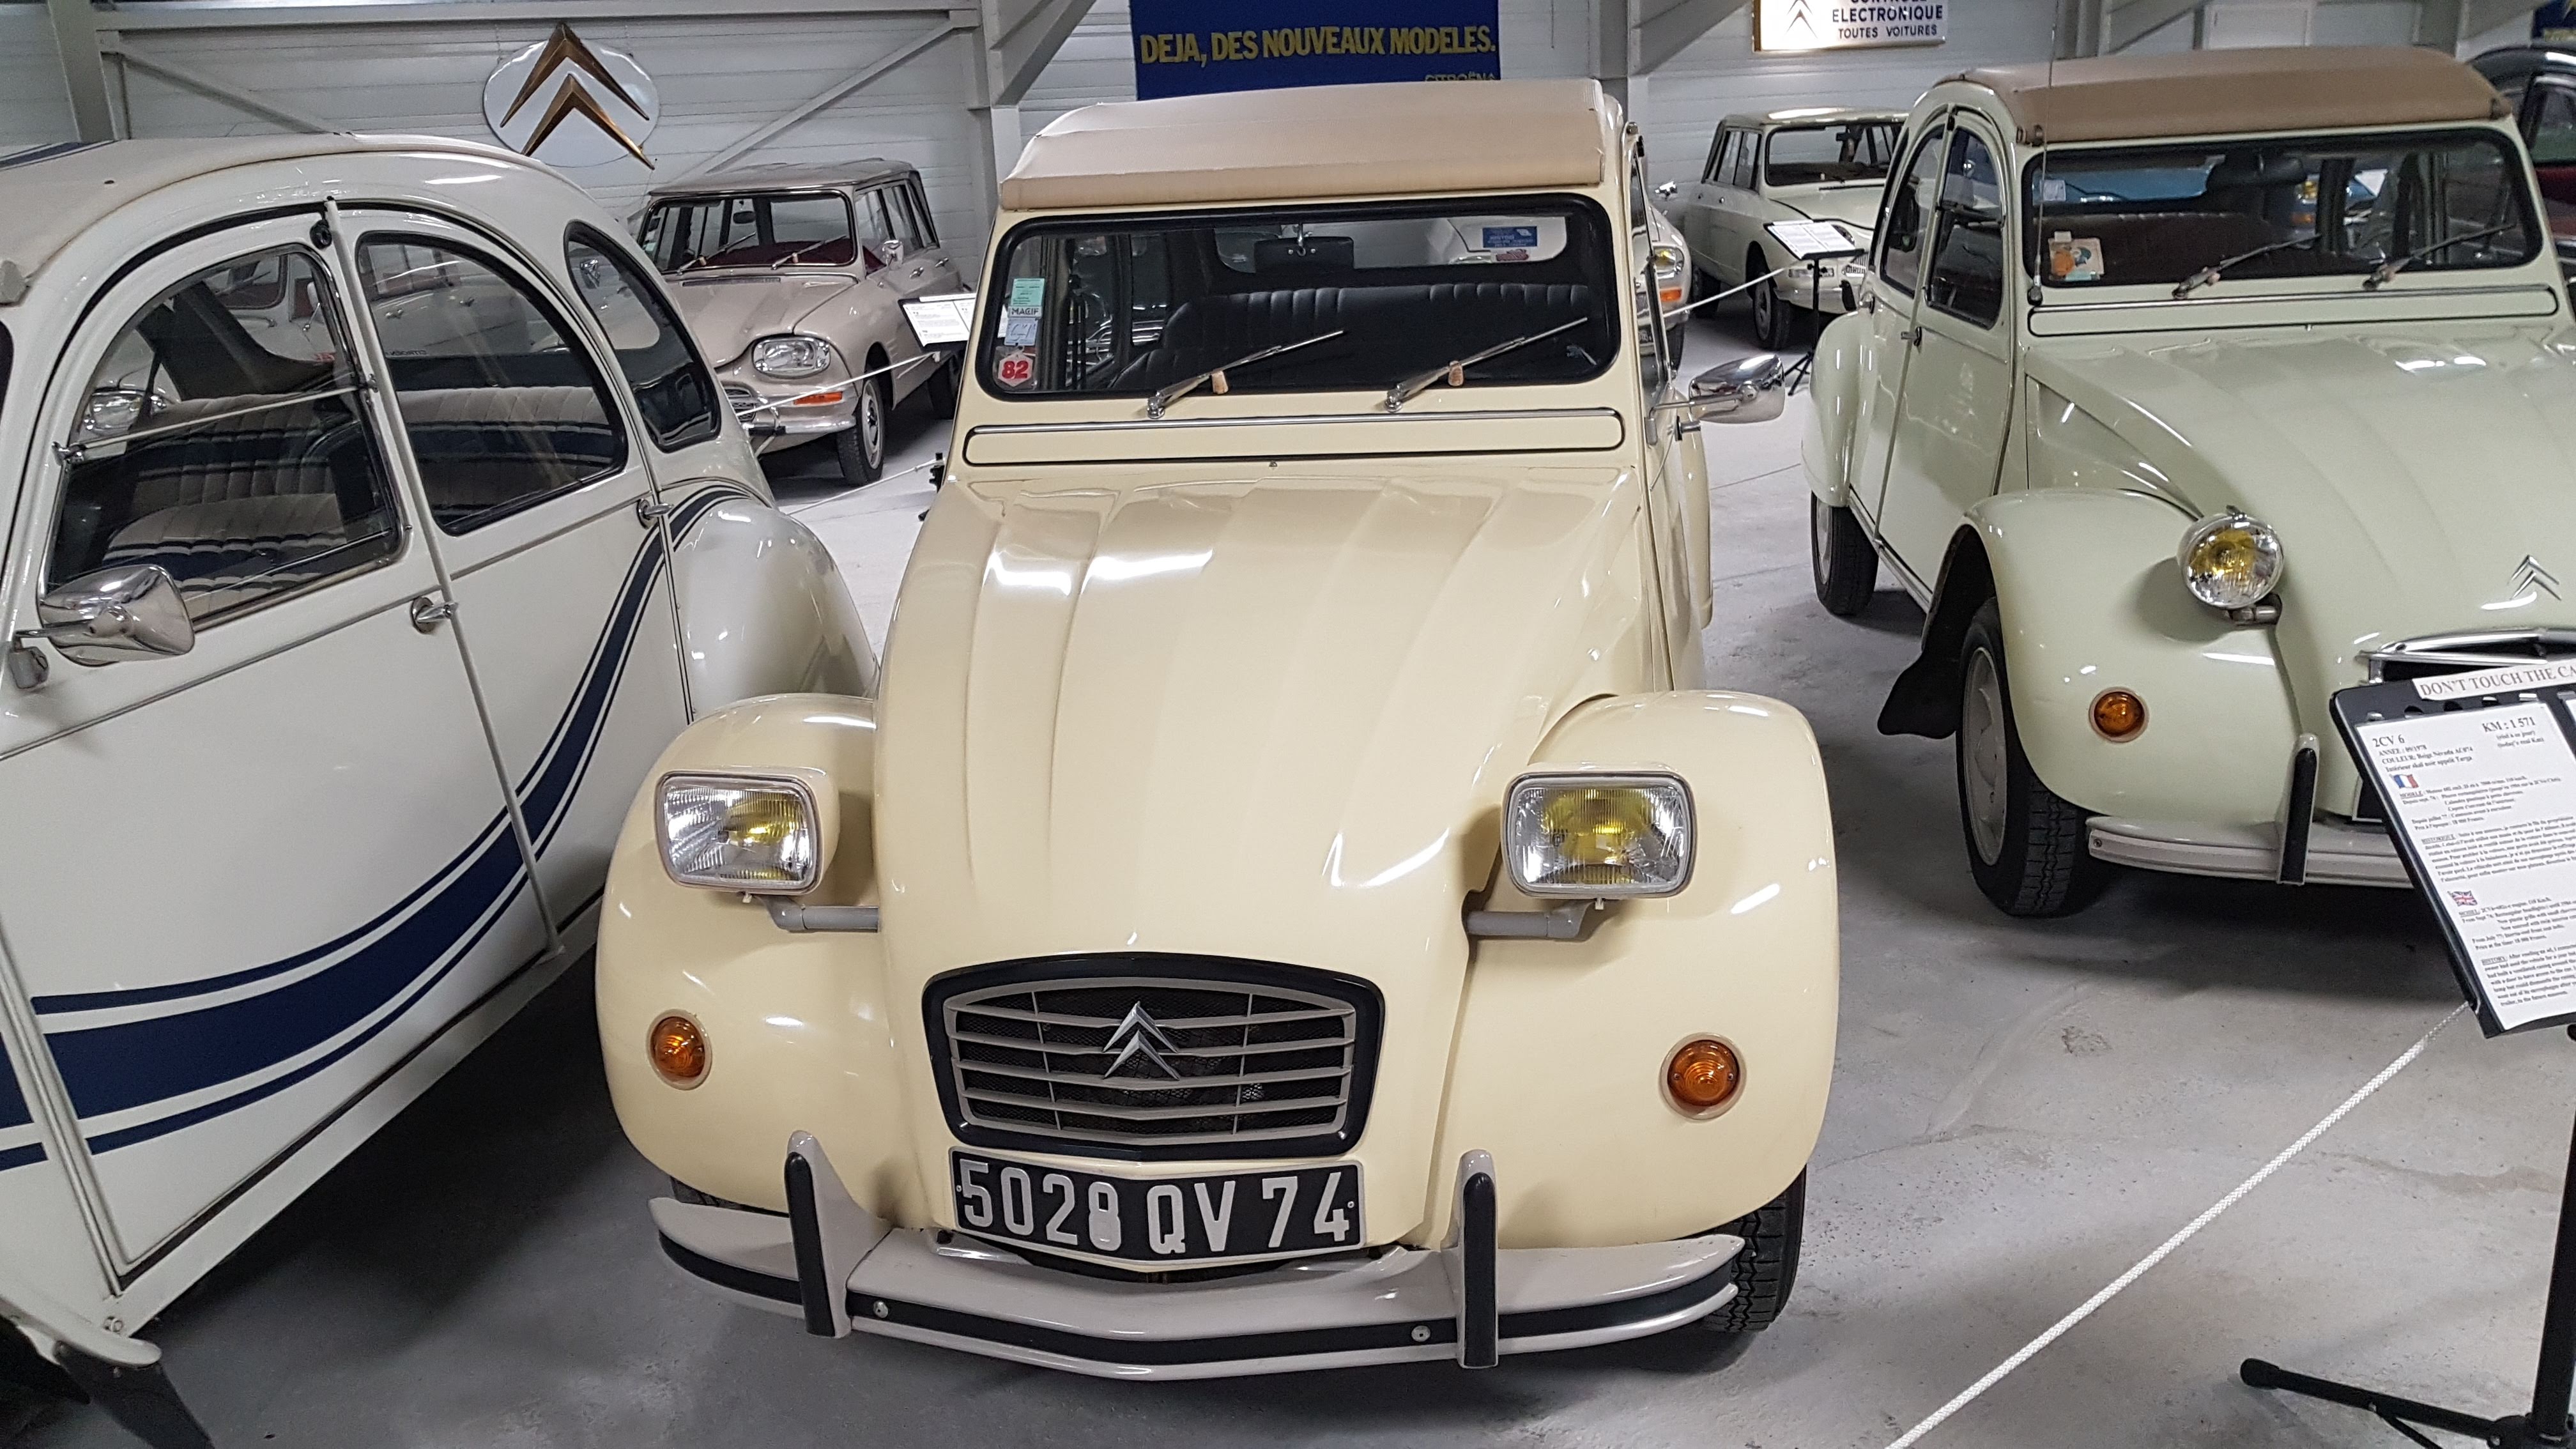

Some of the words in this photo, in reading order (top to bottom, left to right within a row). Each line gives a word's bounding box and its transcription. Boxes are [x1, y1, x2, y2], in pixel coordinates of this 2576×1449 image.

[1832, 4, 1943, 23] ELECTRONIQUE
[1838, 27, 1878, 39] TOUTES
[1886, 24, 1937, 37] VOITURES
[1140, 33, 1208, 68] DEJA,
[1211, 31, 1259, 61] DES
[1262, 26, 1386, 59] NOUVEAUX
[1390, 26, 1497, 56] MODELES.
[1001, 360, 1029, 379] 82
[2420, 679, 2466, 697] DON'T
[2468, 671, 2524, 691] TOUCH
[2524, 666, 2556, 683] THE
[2481, 721, 2503, 733] KM
[2372, 735, 2394, 747] 2CV
[2398, 734, 2405, 744] 6
[959, 1158, 1123, 1252] 5028
[1146, 1179, 1237, 1255] QV
[1261, 1171, 1351, 1249] 74
